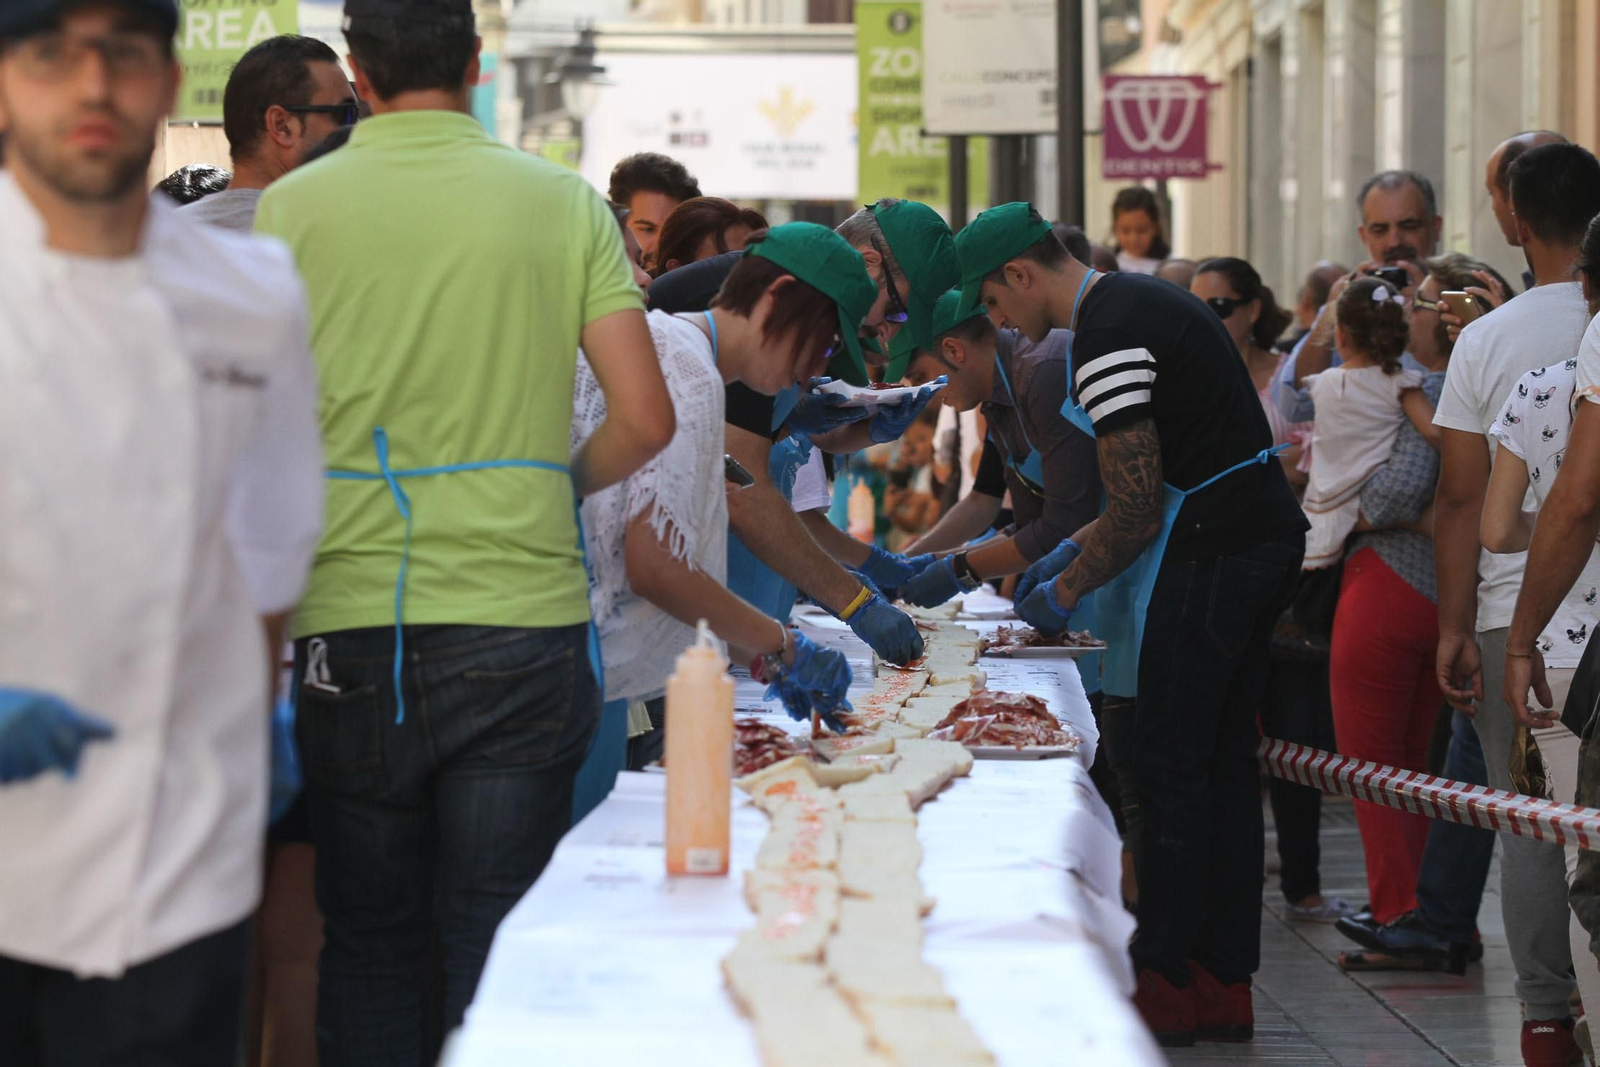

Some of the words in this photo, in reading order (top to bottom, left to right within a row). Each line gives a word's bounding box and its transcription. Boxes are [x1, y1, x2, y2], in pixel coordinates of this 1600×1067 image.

[173, 10, 279, 49] REA
[869, 46, 921, 77] ZO
[869, 125, 973, 157] ARE
[1104, 158, 1201, 174] DENTIX
[1532, 1026, 1555, 1034] adidas
